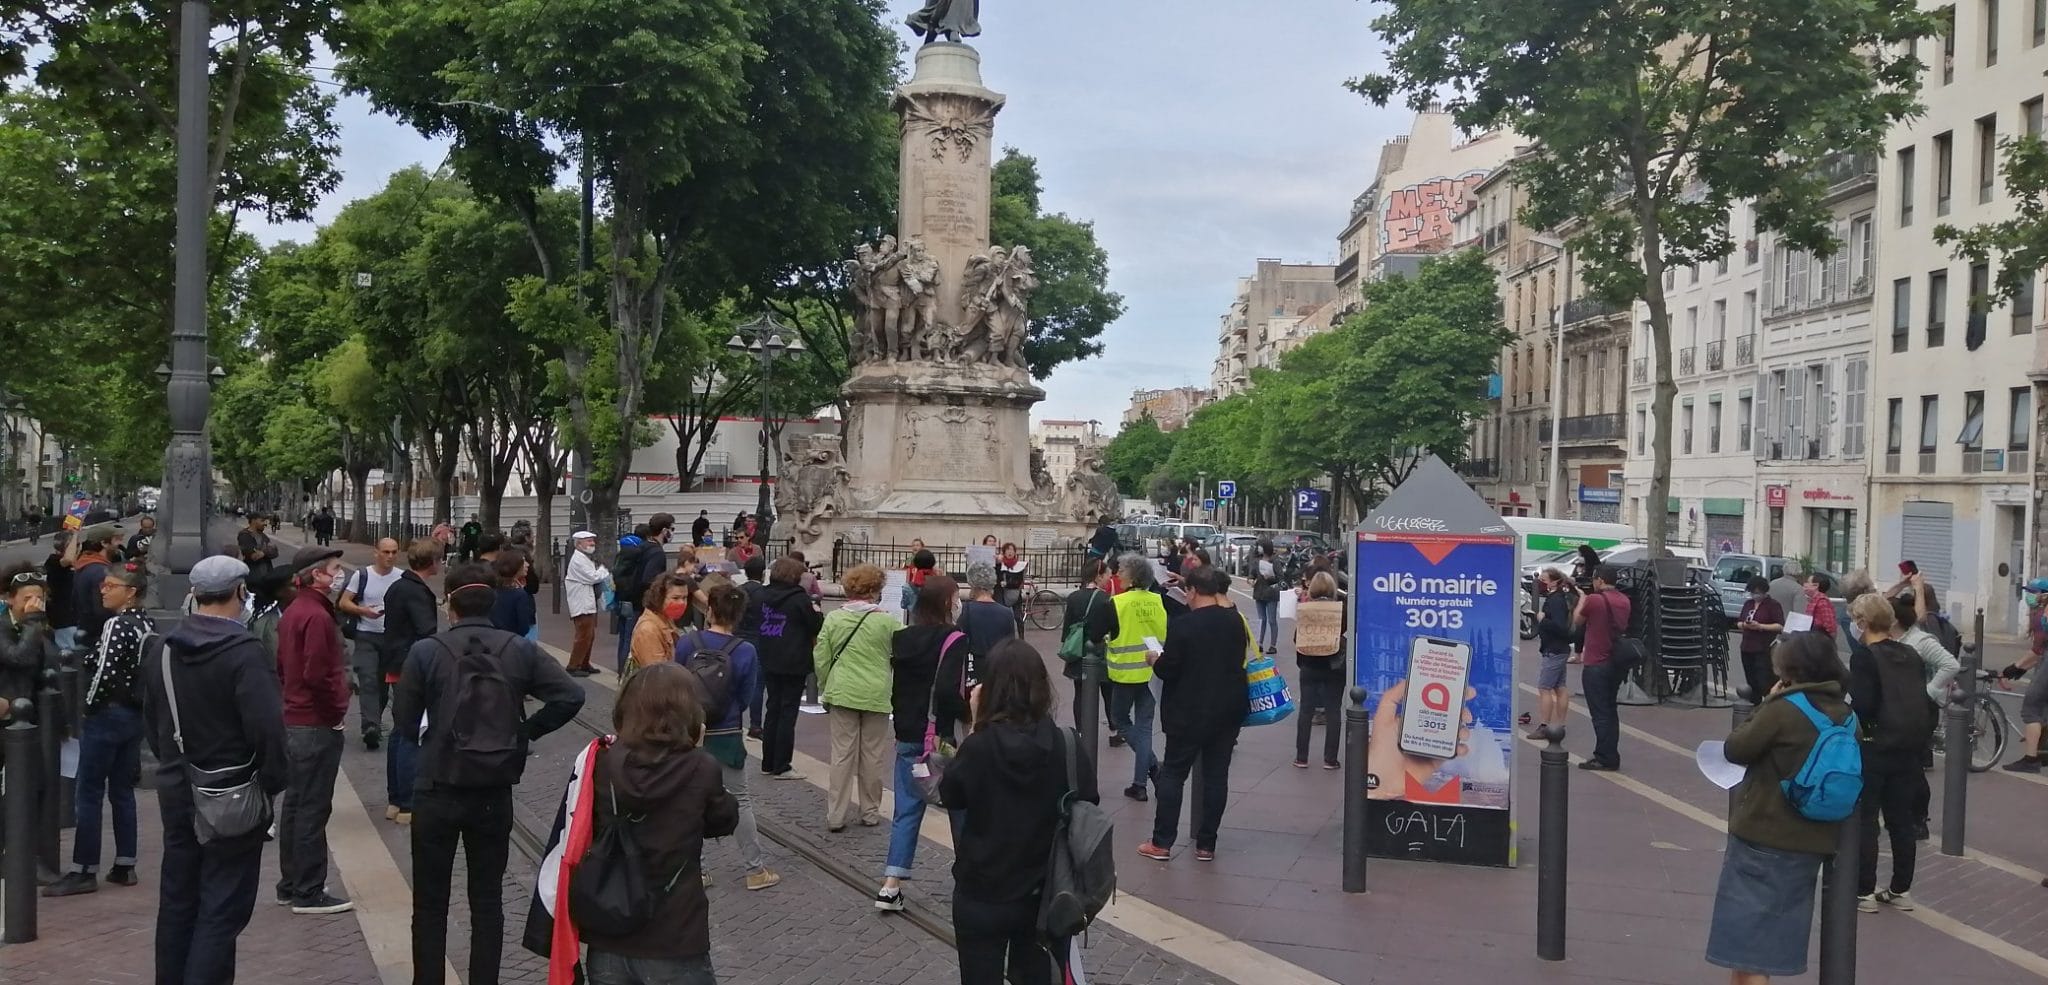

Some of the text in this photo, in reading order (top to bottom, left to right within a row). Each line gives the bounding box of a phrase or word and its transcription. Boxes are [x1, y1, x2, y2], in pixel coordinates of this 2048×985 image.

[1299, 494, 1308, 508] P
[1373, 572, 1497, 596] allô mairie
[1396, 596, 1473, 608] Numéro gratuit
[1406, 608, 1463, 629] 3013
[1424, 720, 1446, 730] 3013
[1386, 811, 1466, 848] GALA
